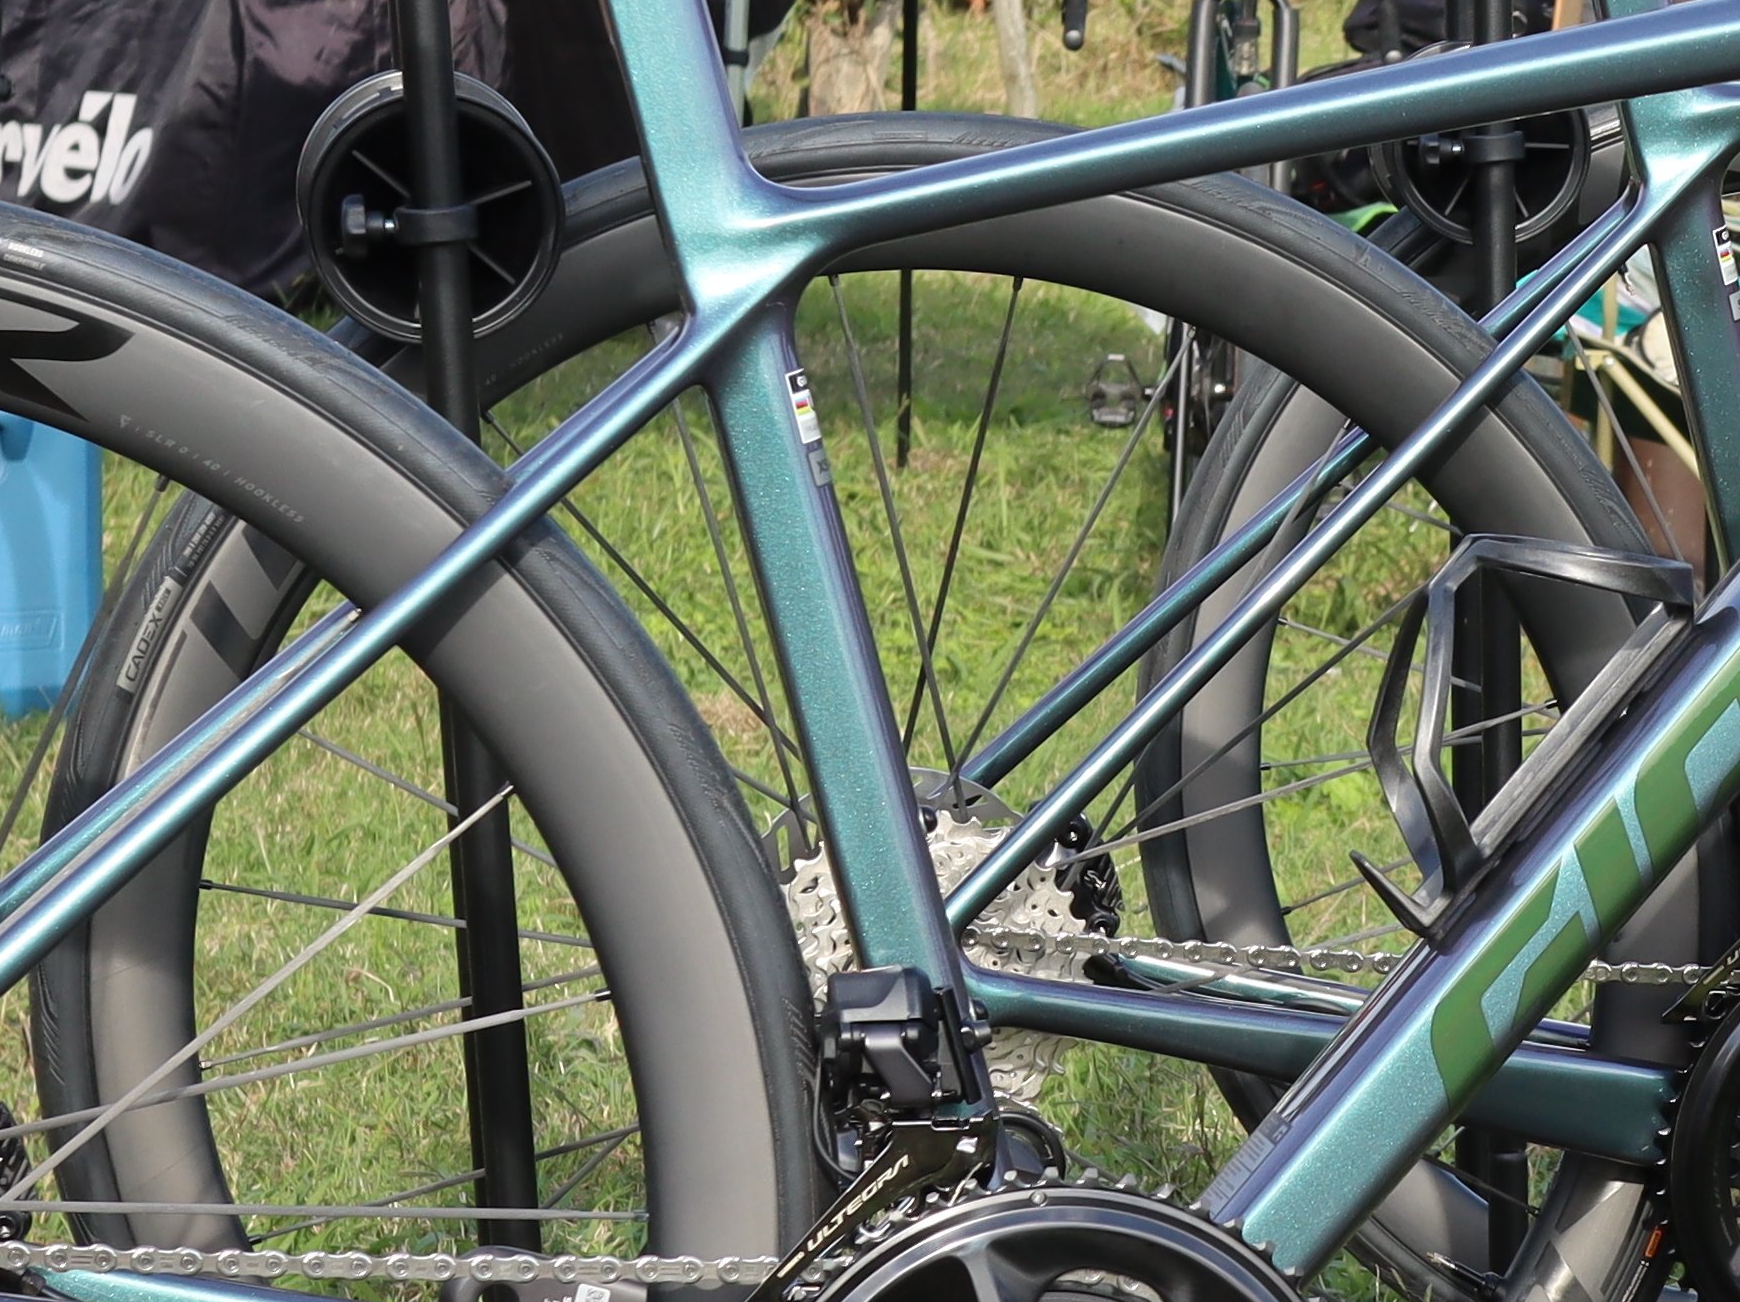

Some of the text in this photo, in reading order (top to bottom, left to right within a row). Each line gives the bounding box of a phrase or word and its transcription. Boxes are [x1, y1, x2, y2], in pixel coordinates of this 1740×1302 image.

[233, 475, 306, 524] HOOKLESS
[125, 611, 164, 683] CADEX
[807, 1154, 910, 1252] ULTEGRA
